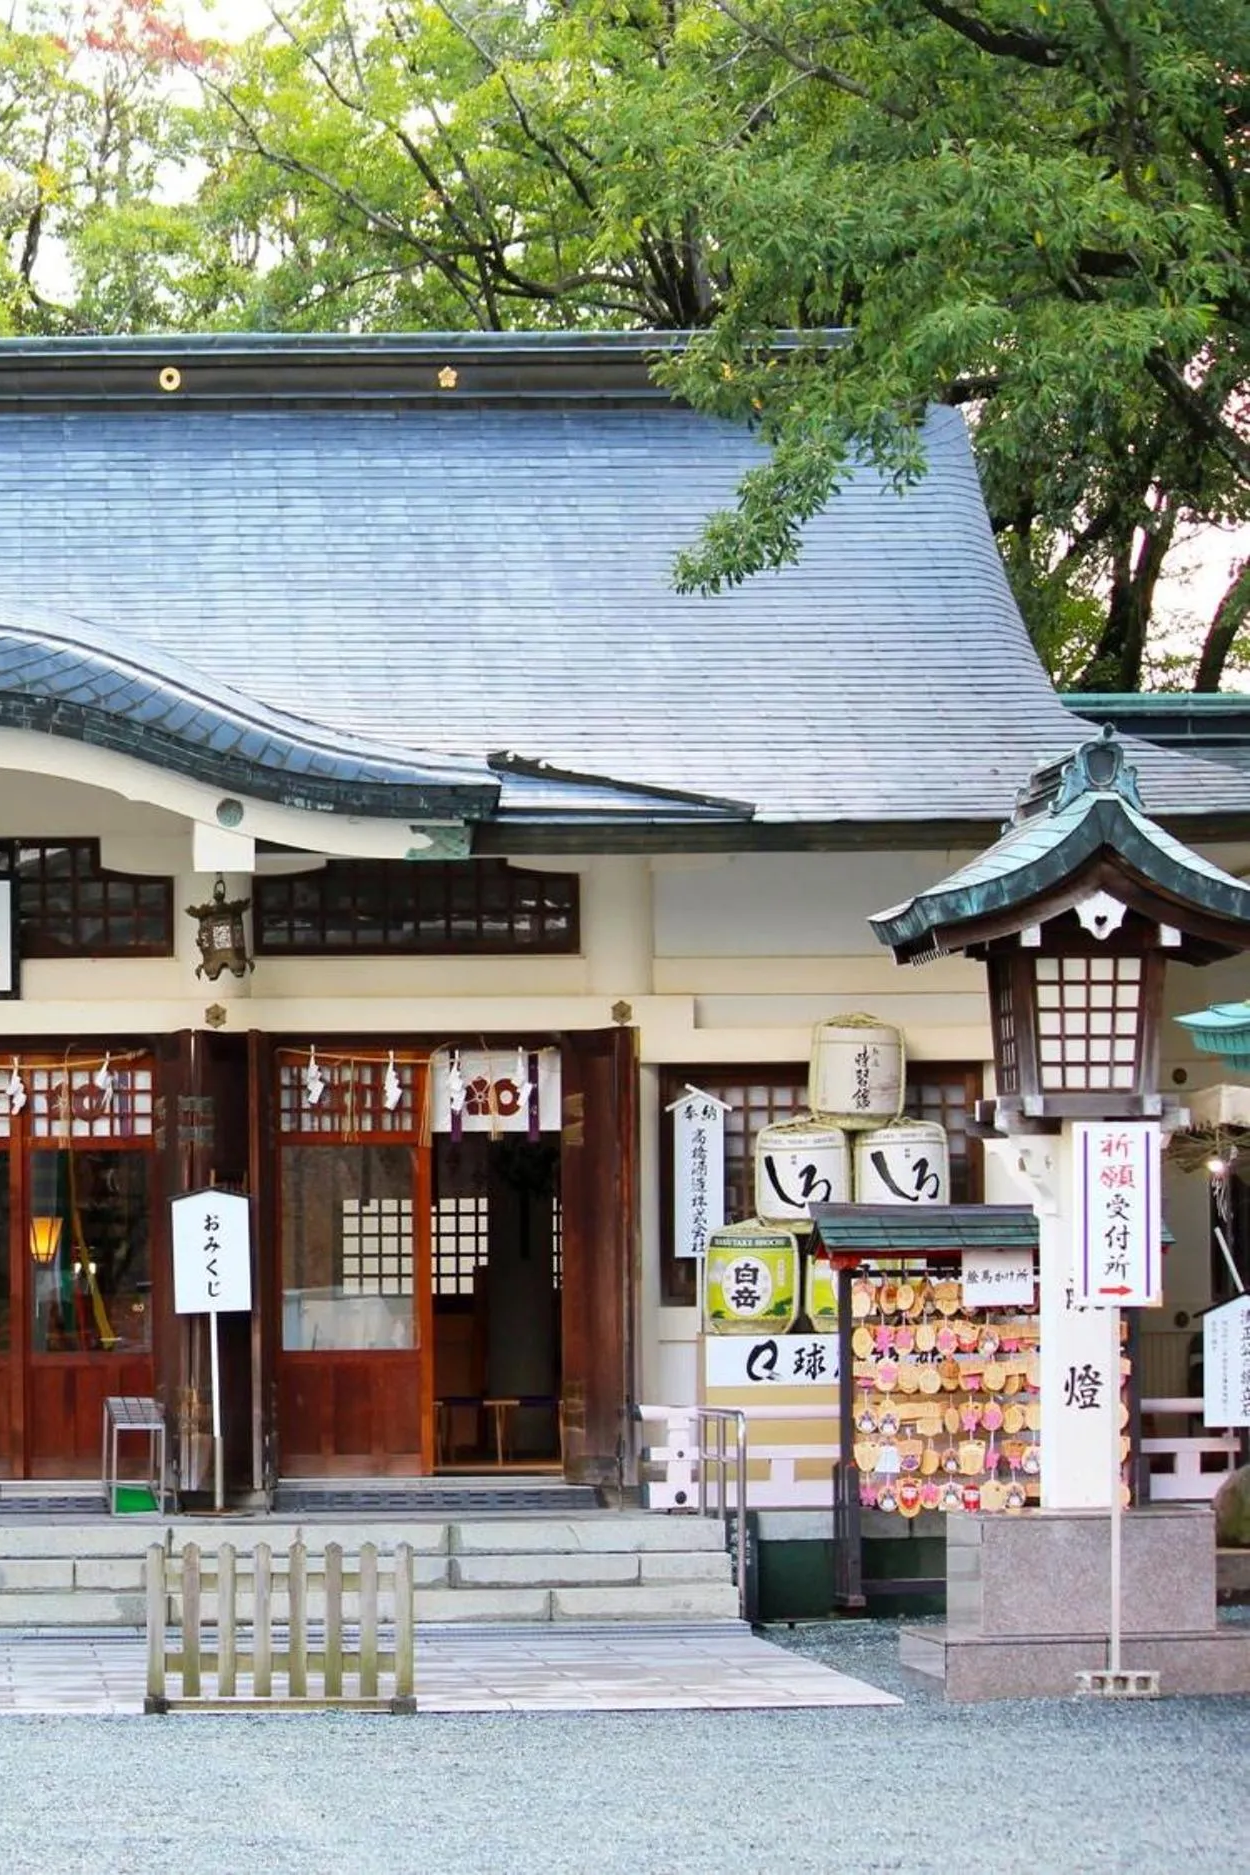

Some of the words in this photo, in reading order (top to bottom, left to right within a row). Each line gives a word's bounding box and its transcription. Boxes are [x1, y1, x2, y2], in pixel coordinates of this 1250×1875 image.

[682, 1104, 717, 1121] 奉納
[764, 1155, 832, 1208] しろ
[870, 1151, 940, 1201] しろ
[1100, 1133, 1135, 1280] 祈願受付所
[203, 1213, 222, 1298] おみくじ
[966, 1268, 1029, 1285] 絵馬かけ所
[731, 1263, 761, 1309] 白岳
[793, 1343, 839, 1381] 球
